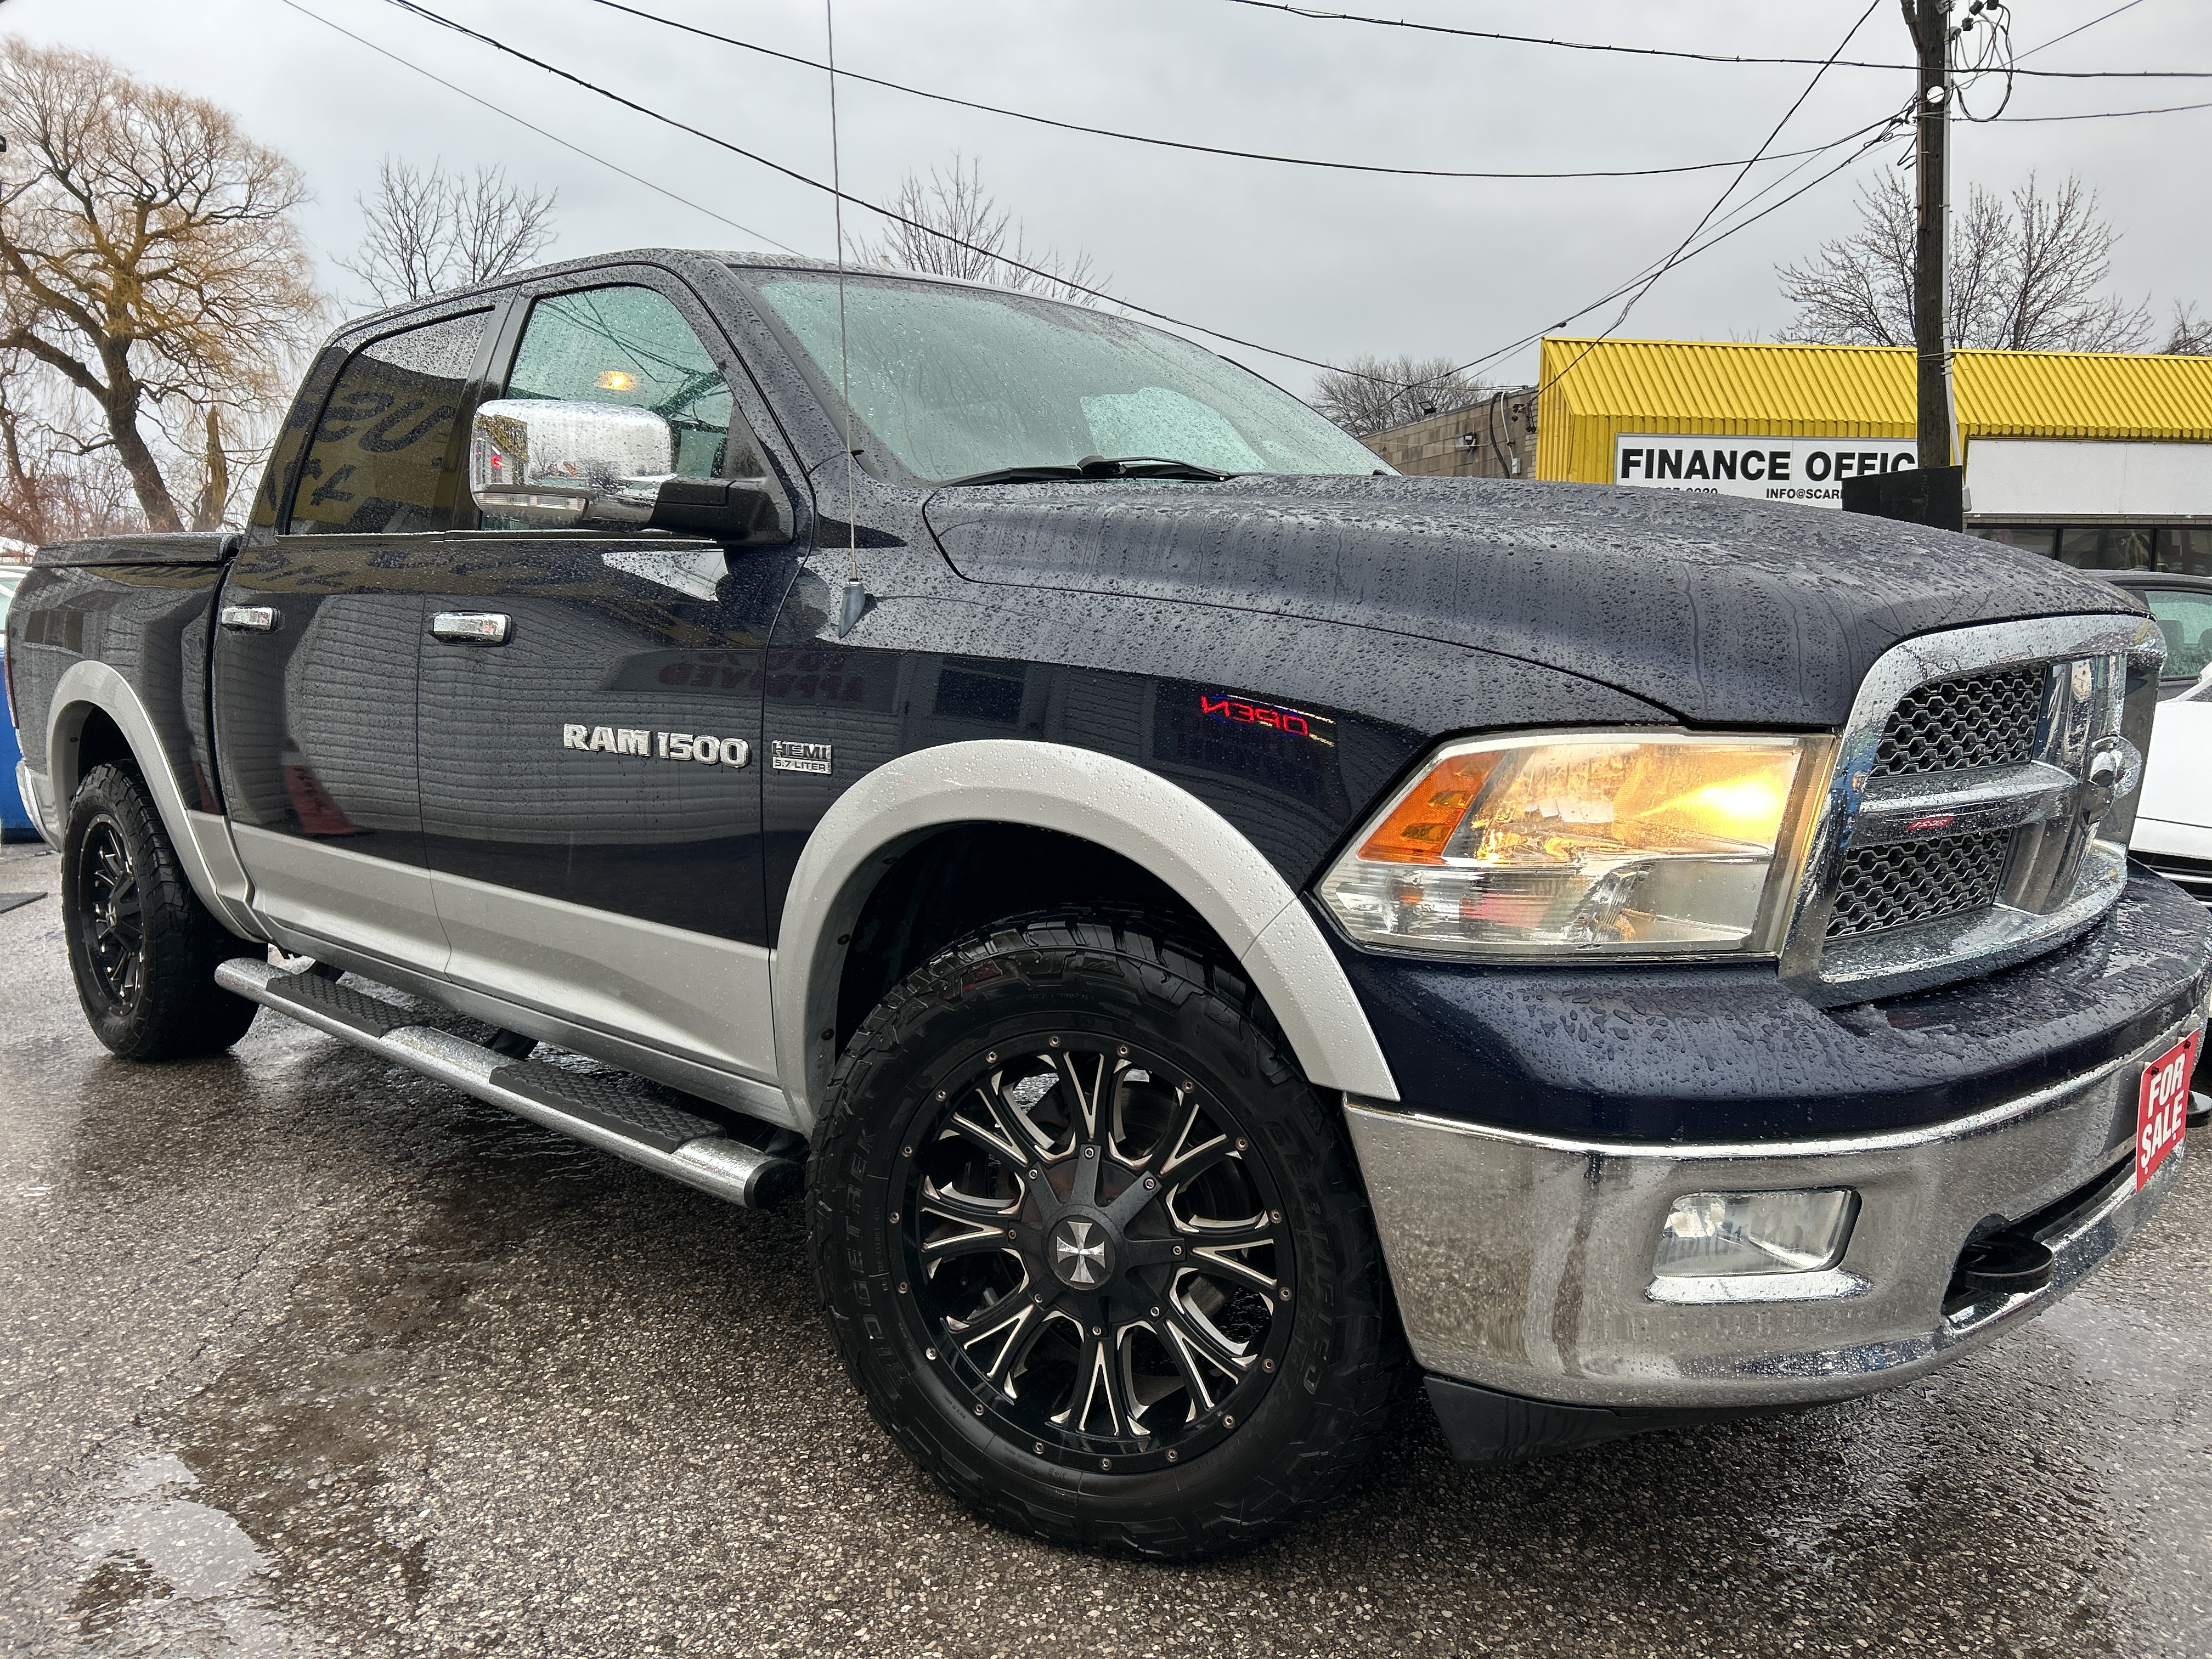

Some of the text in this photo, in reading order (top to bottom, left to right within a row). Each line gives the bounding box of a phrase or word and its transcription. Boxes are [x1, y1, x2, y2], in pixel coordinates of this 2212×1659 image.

[1621, 448, 1915, 481] FINANCE OFFIC
[1766, 488, 1842, 499] INFO@SCAR
[563, 723, 749, 768] RAM 1500
[772, 741, 831, 761] HEMI
[775, 759, 826, 771] 5.7 LITER
[2148, 1053, 2186, 1119] FOR
[2141, 1090, 2185, 1169] SALE
